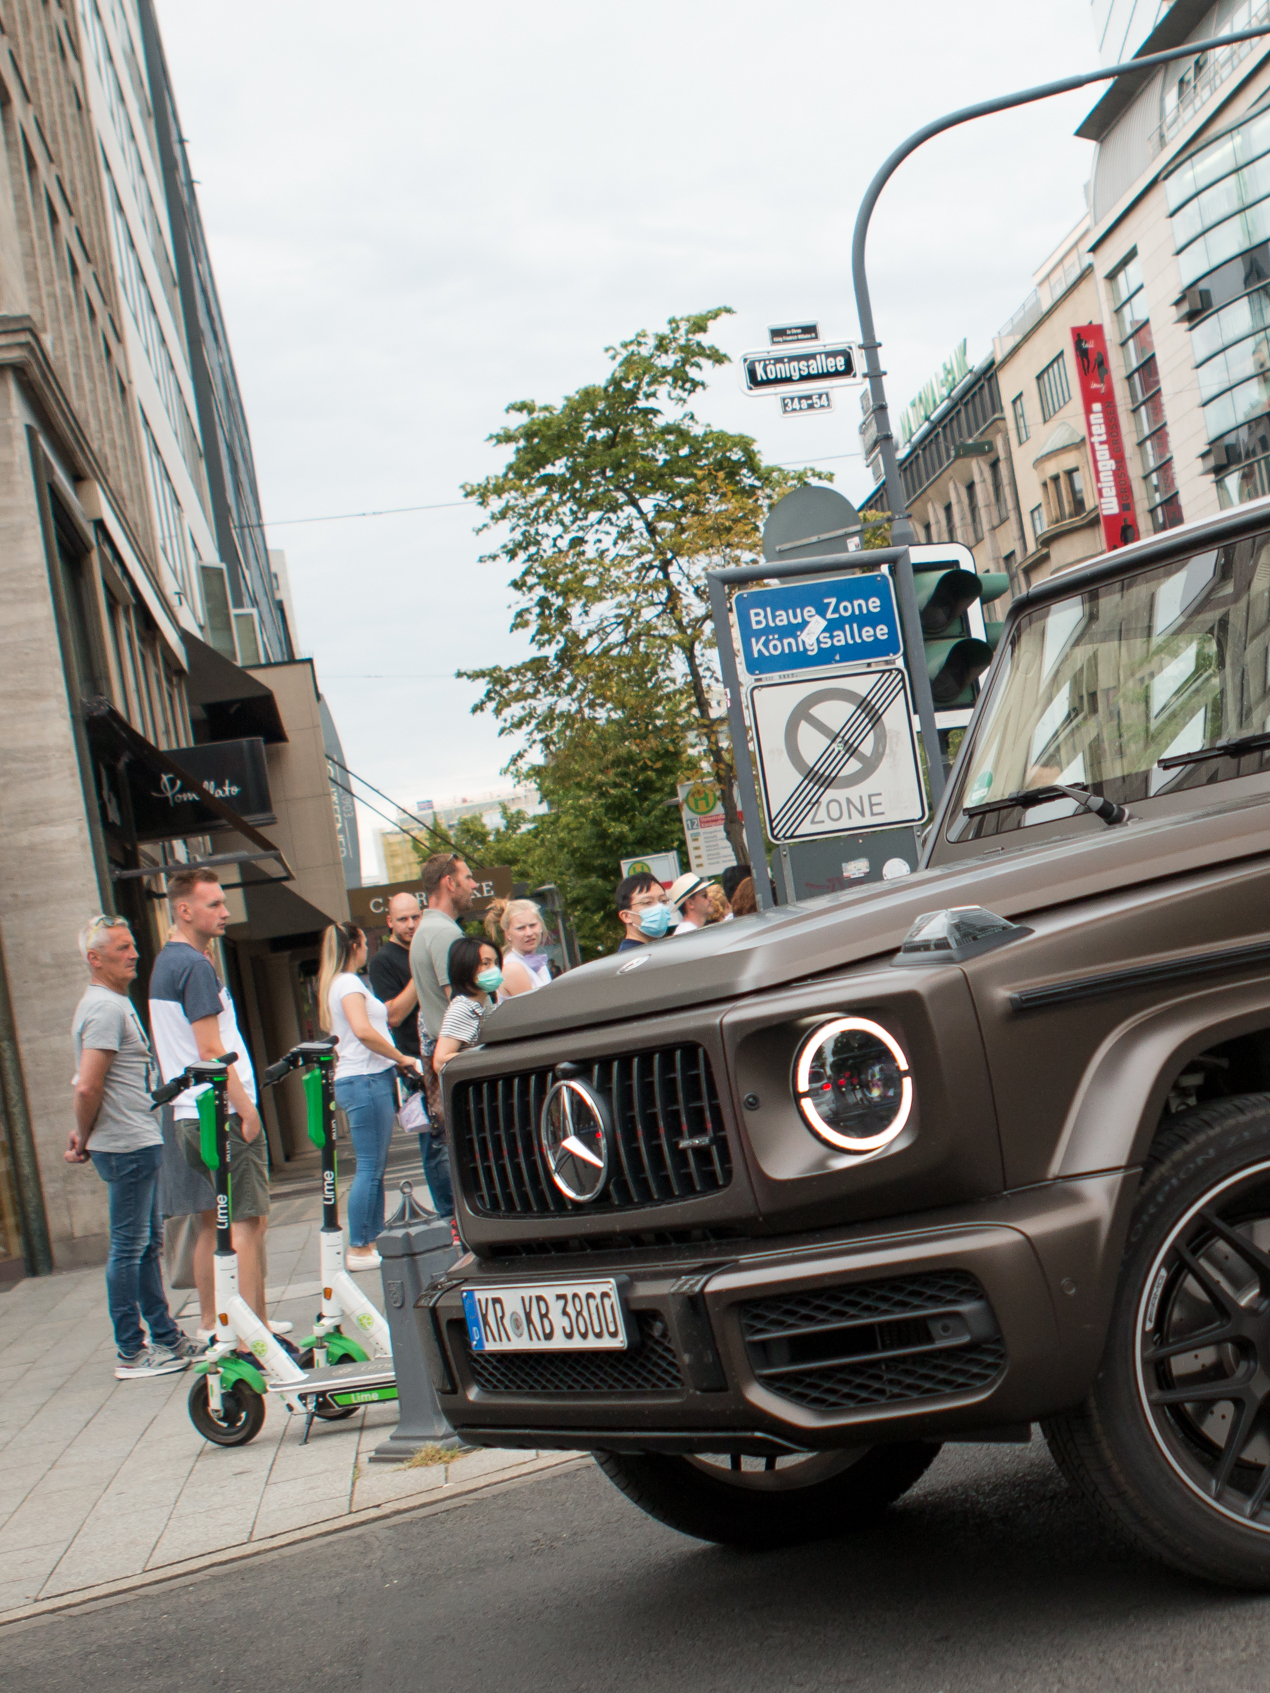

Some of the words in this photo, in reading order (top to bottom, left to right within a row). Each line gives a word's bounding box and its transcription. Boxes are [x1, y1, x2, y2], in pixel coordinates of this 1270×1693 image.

[755, 353, 845, 381] Königsallee
[784, 393, 829, 412] 34a-54
[1105, 401, 1122, 454] GRÖSSEN
[1114, 456, 1131, 502] GROSSE
[750, 605, 817, 630] Blaue
[823, 597, 881, 619] Zone
[686, 818, 699, 831] 12
[810, 792, 885, 825] ZONE
[323, 1169, 334, 1205] Lime
[216, 1193, 228, 1230] Lime
[477, 1296, 512, 1343] KR
[521, 1294, 555, 1342] KB
[555, 1290, 619, 1340] 3800
[351, 1391, 380, 1404] Lime
